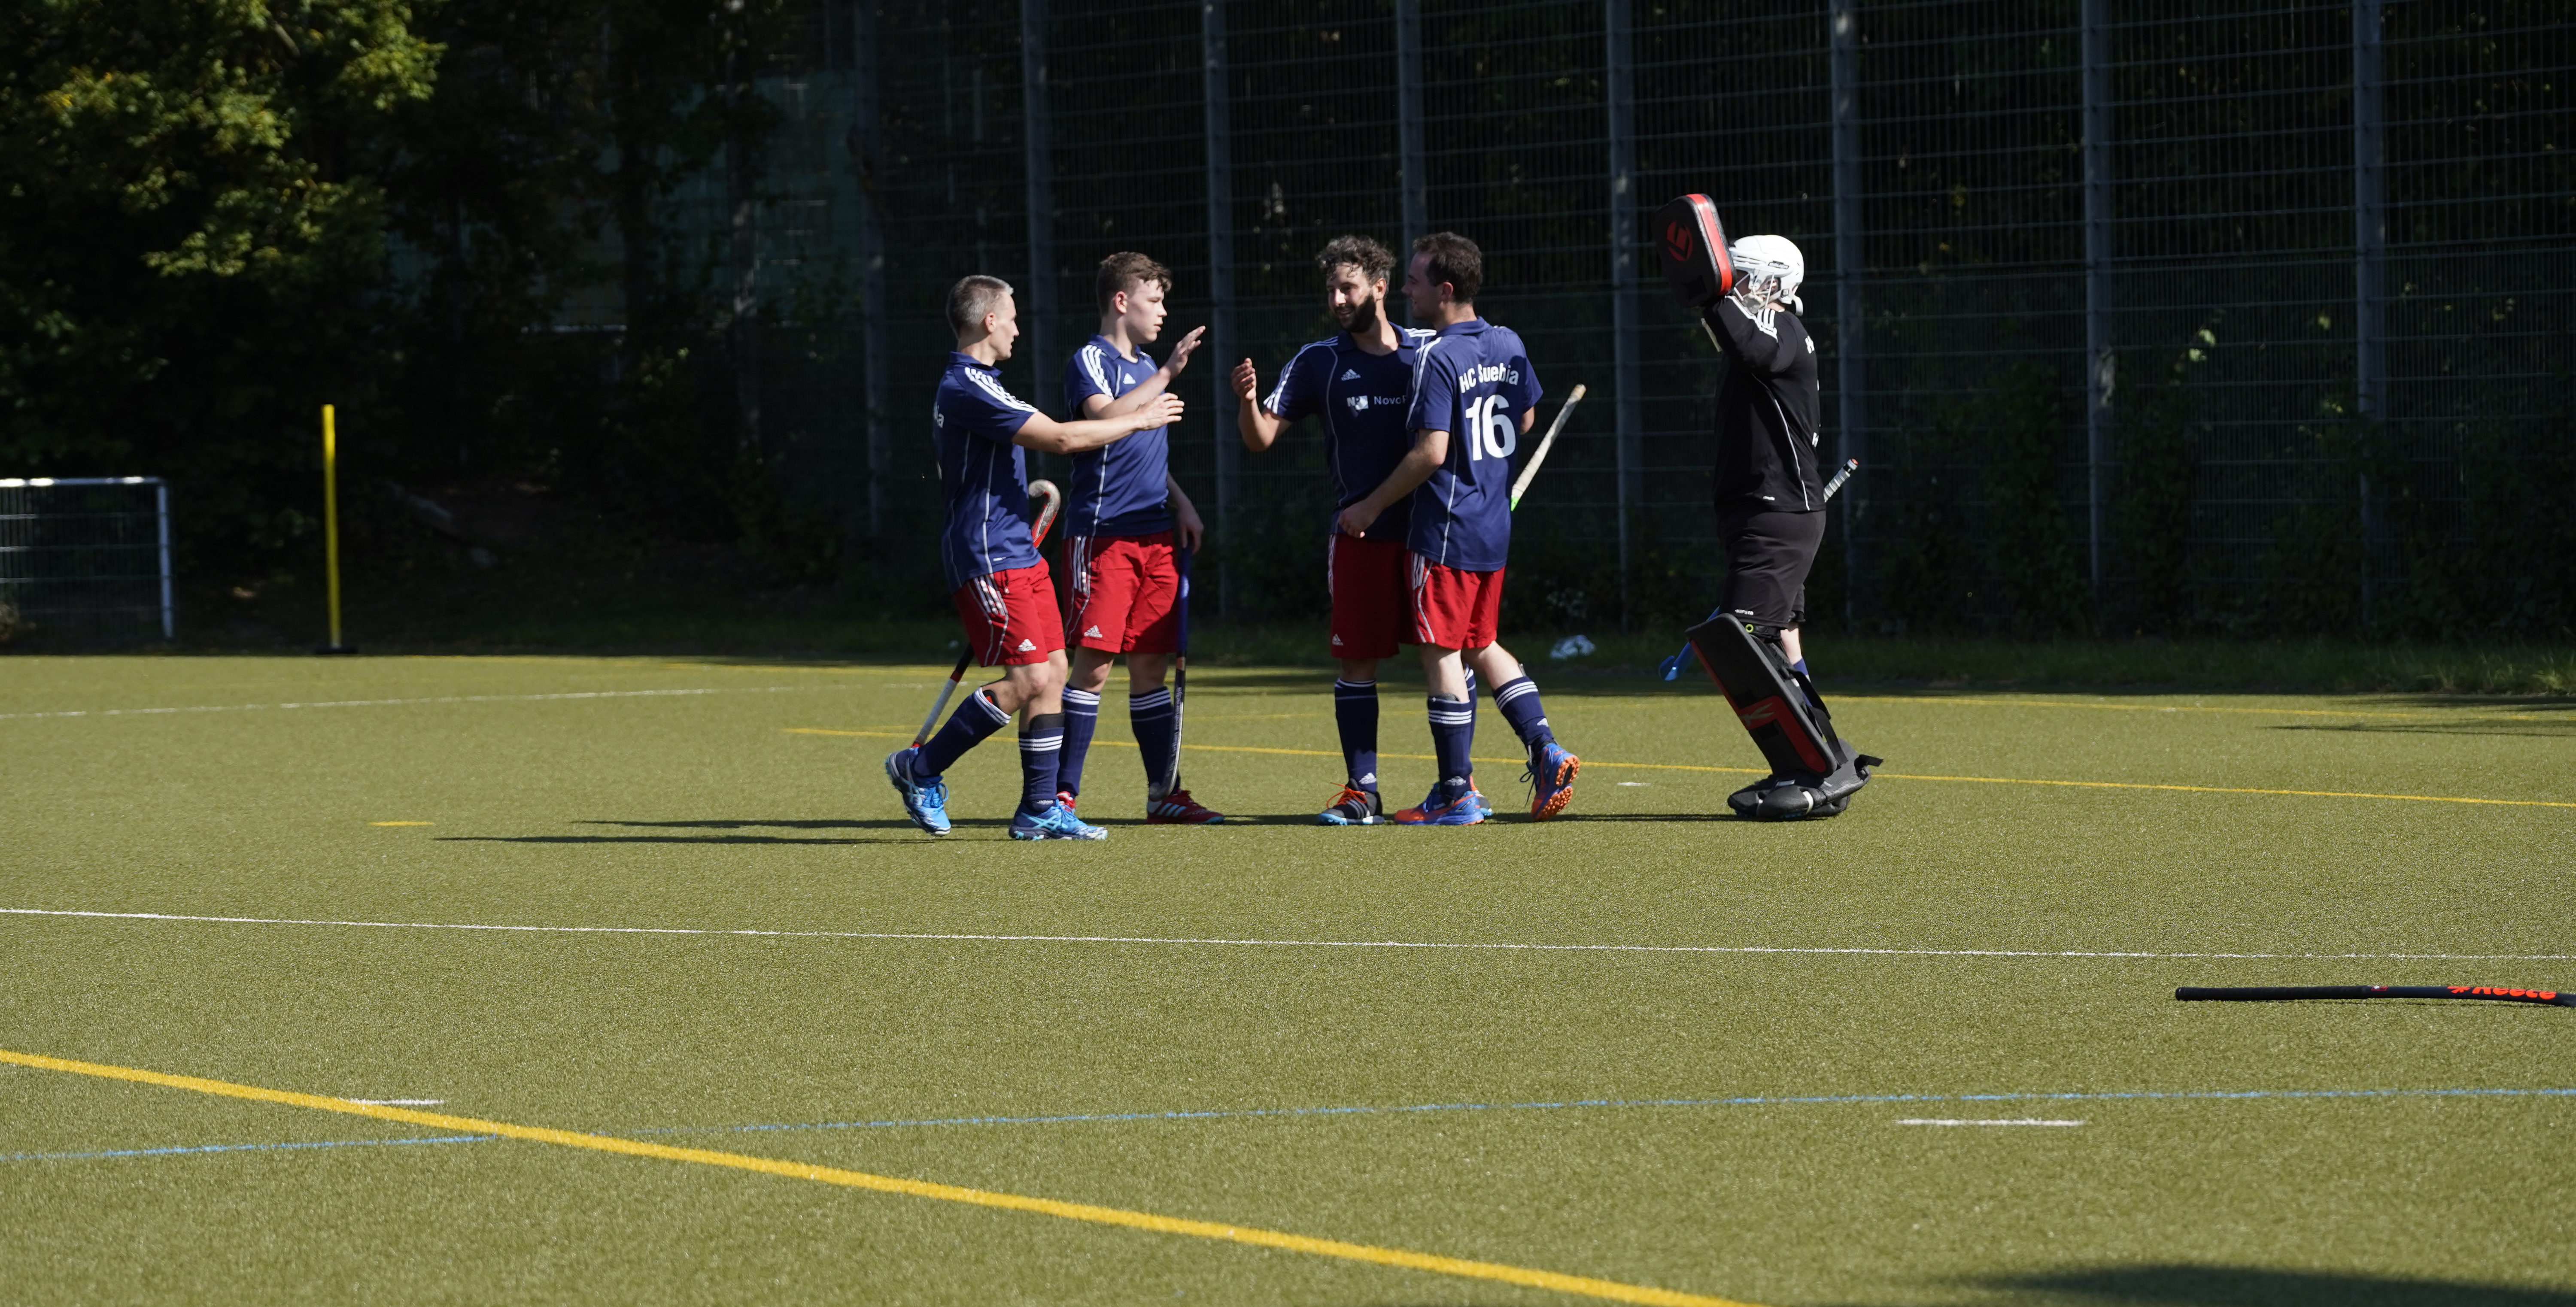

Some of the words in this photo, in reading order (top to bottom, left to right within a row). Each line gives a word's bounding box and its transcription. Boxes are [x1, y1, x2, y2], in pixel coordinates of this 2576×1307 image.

[1459, 368, 1476, 394] HC
[1478, 362, 1519, 385] Suebia
[1465, 395, 1516, 461] 16
